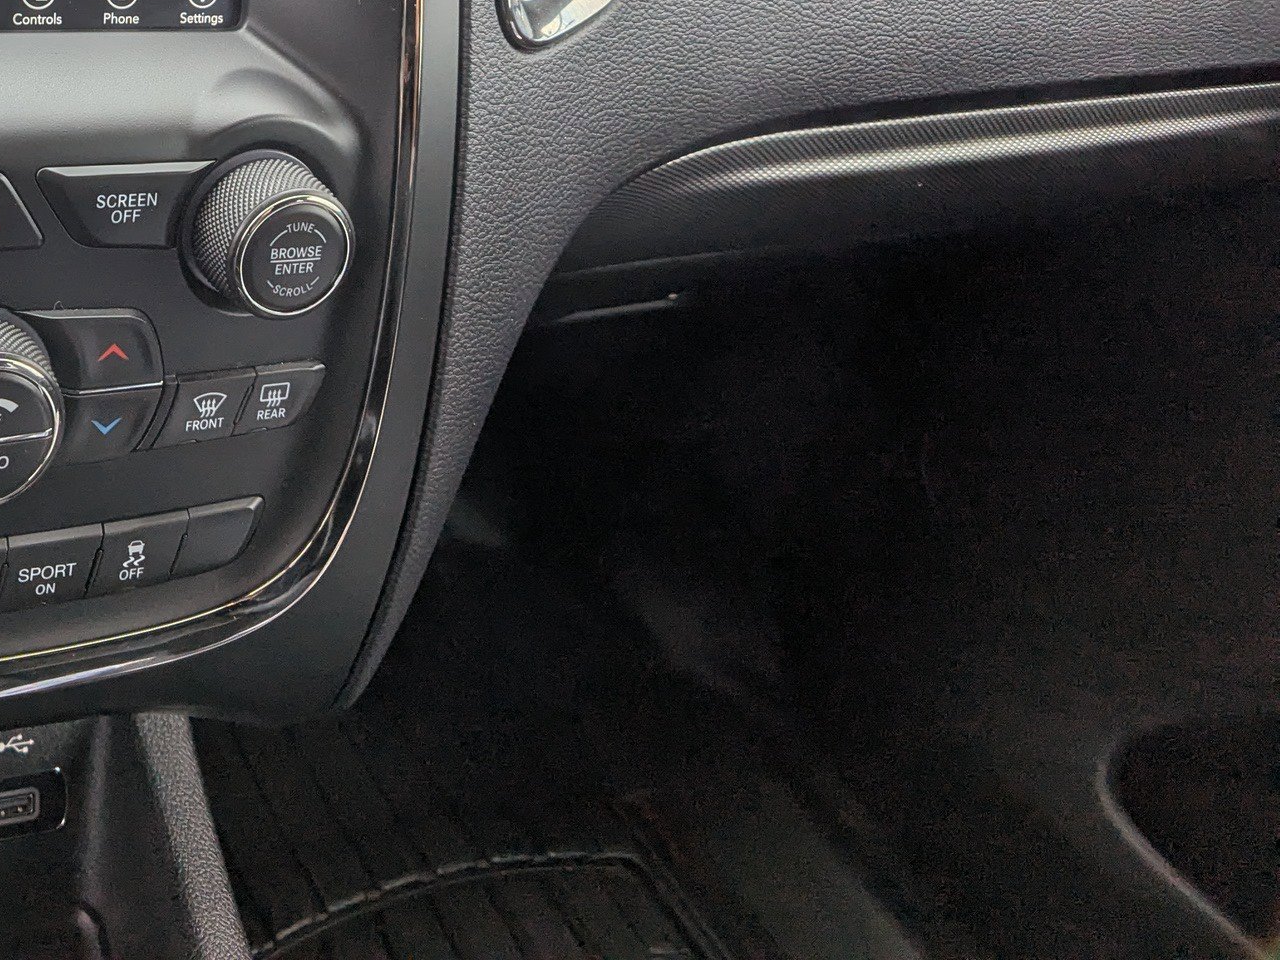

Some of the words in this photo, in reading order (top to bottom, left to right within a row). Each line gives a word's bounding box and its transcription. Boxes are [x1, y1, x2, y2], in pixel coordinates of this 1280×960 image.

[12, 12, 63, 26] Controls
[103, 13, 140, 25] Phone
[179, 12, 224, 26] Settings
[96, 192, 158, 208] SCREEN
[110, 209, 142, 224] OFF
[285, 221, 315, 234] TUNE
[270, 245, 323, 259] BROWSE
[274, 263, 314, 275] ENTER
[272, 283, 314, 297] SCROLL
[257, 408, 285, 420] REAR
[186, 418, 224, 431] FRONT
[18, 563, 77, 583] SPORT
[118, 567, 145, 581] OFF
[36, 583, 55, 595] ON
